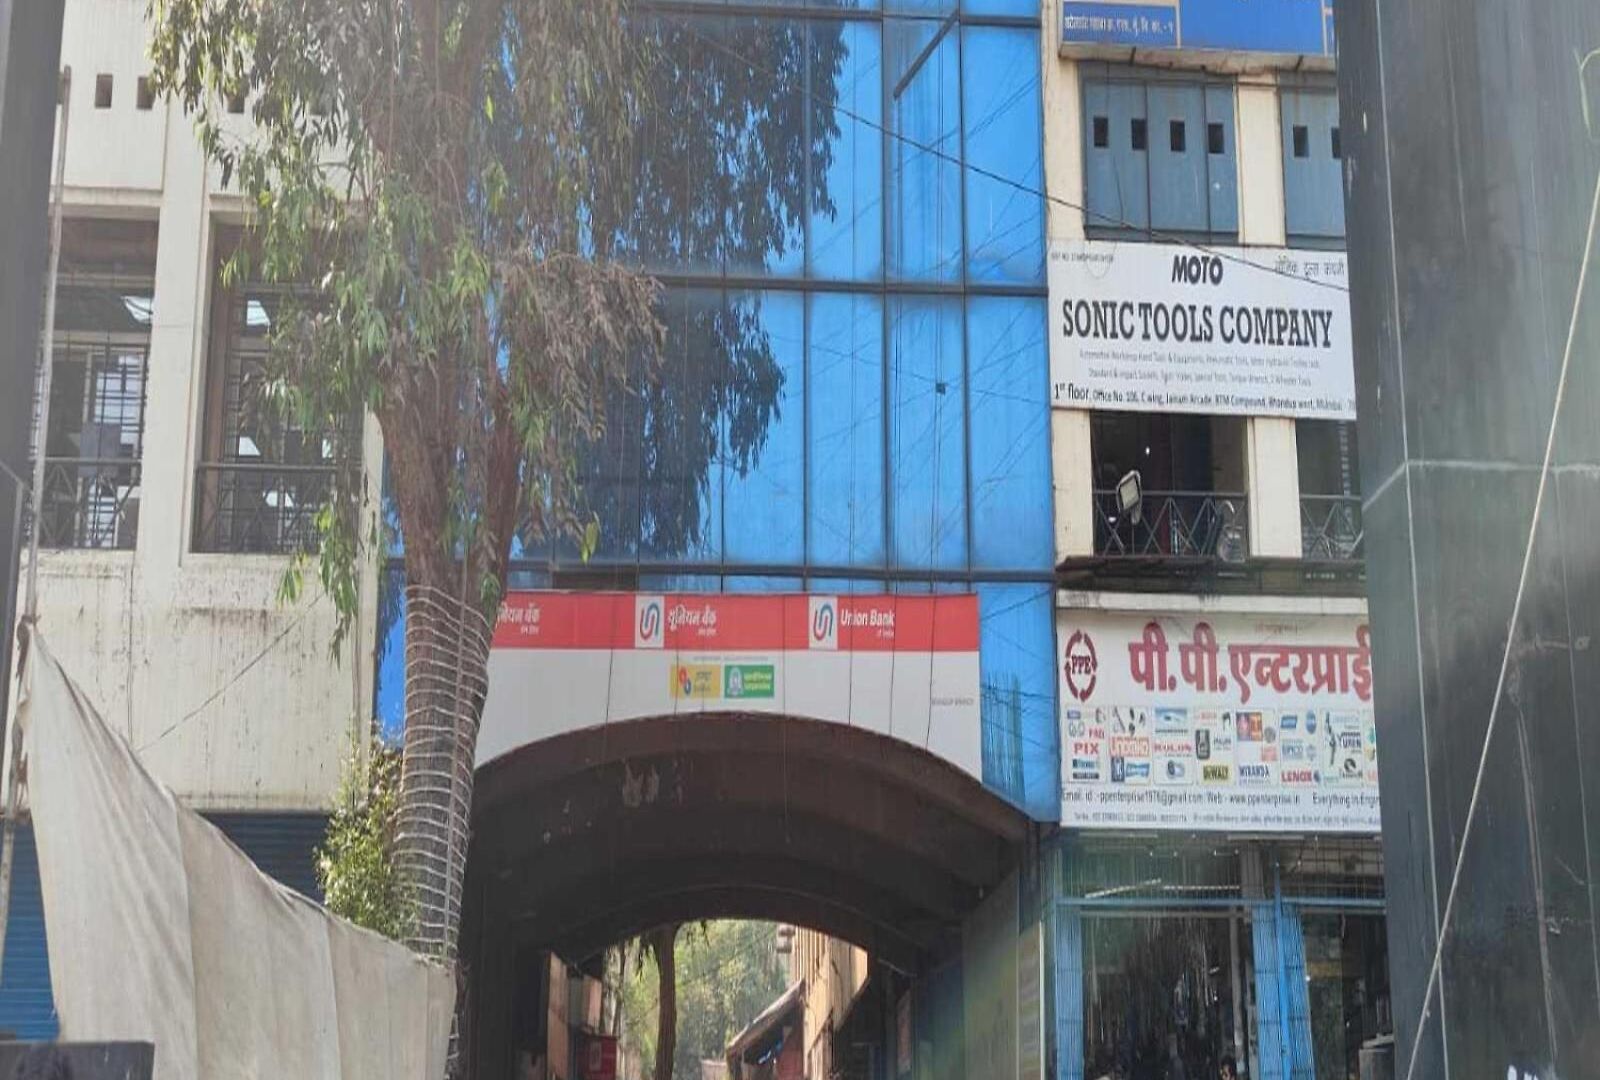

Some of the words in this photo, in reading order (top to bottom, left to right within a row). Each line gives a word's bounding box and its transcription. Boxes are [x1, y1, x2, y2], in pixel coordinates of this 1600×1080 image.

[1171, 255, 1223, 285] MOTO
[1062, 299, 1134, 340] SONIC
[1138, 302, 1213, 343] TOOLS
[1218, 306, 1333, 349] COMPANY
[840, 608, 868, 626] Union
[869, 609, 896, 627] Bank
[1071, 655, 1092, 674] PPE
[1073, 742, 1099, 755] PIX
[1280, 770, 1312, 783] LENOX
